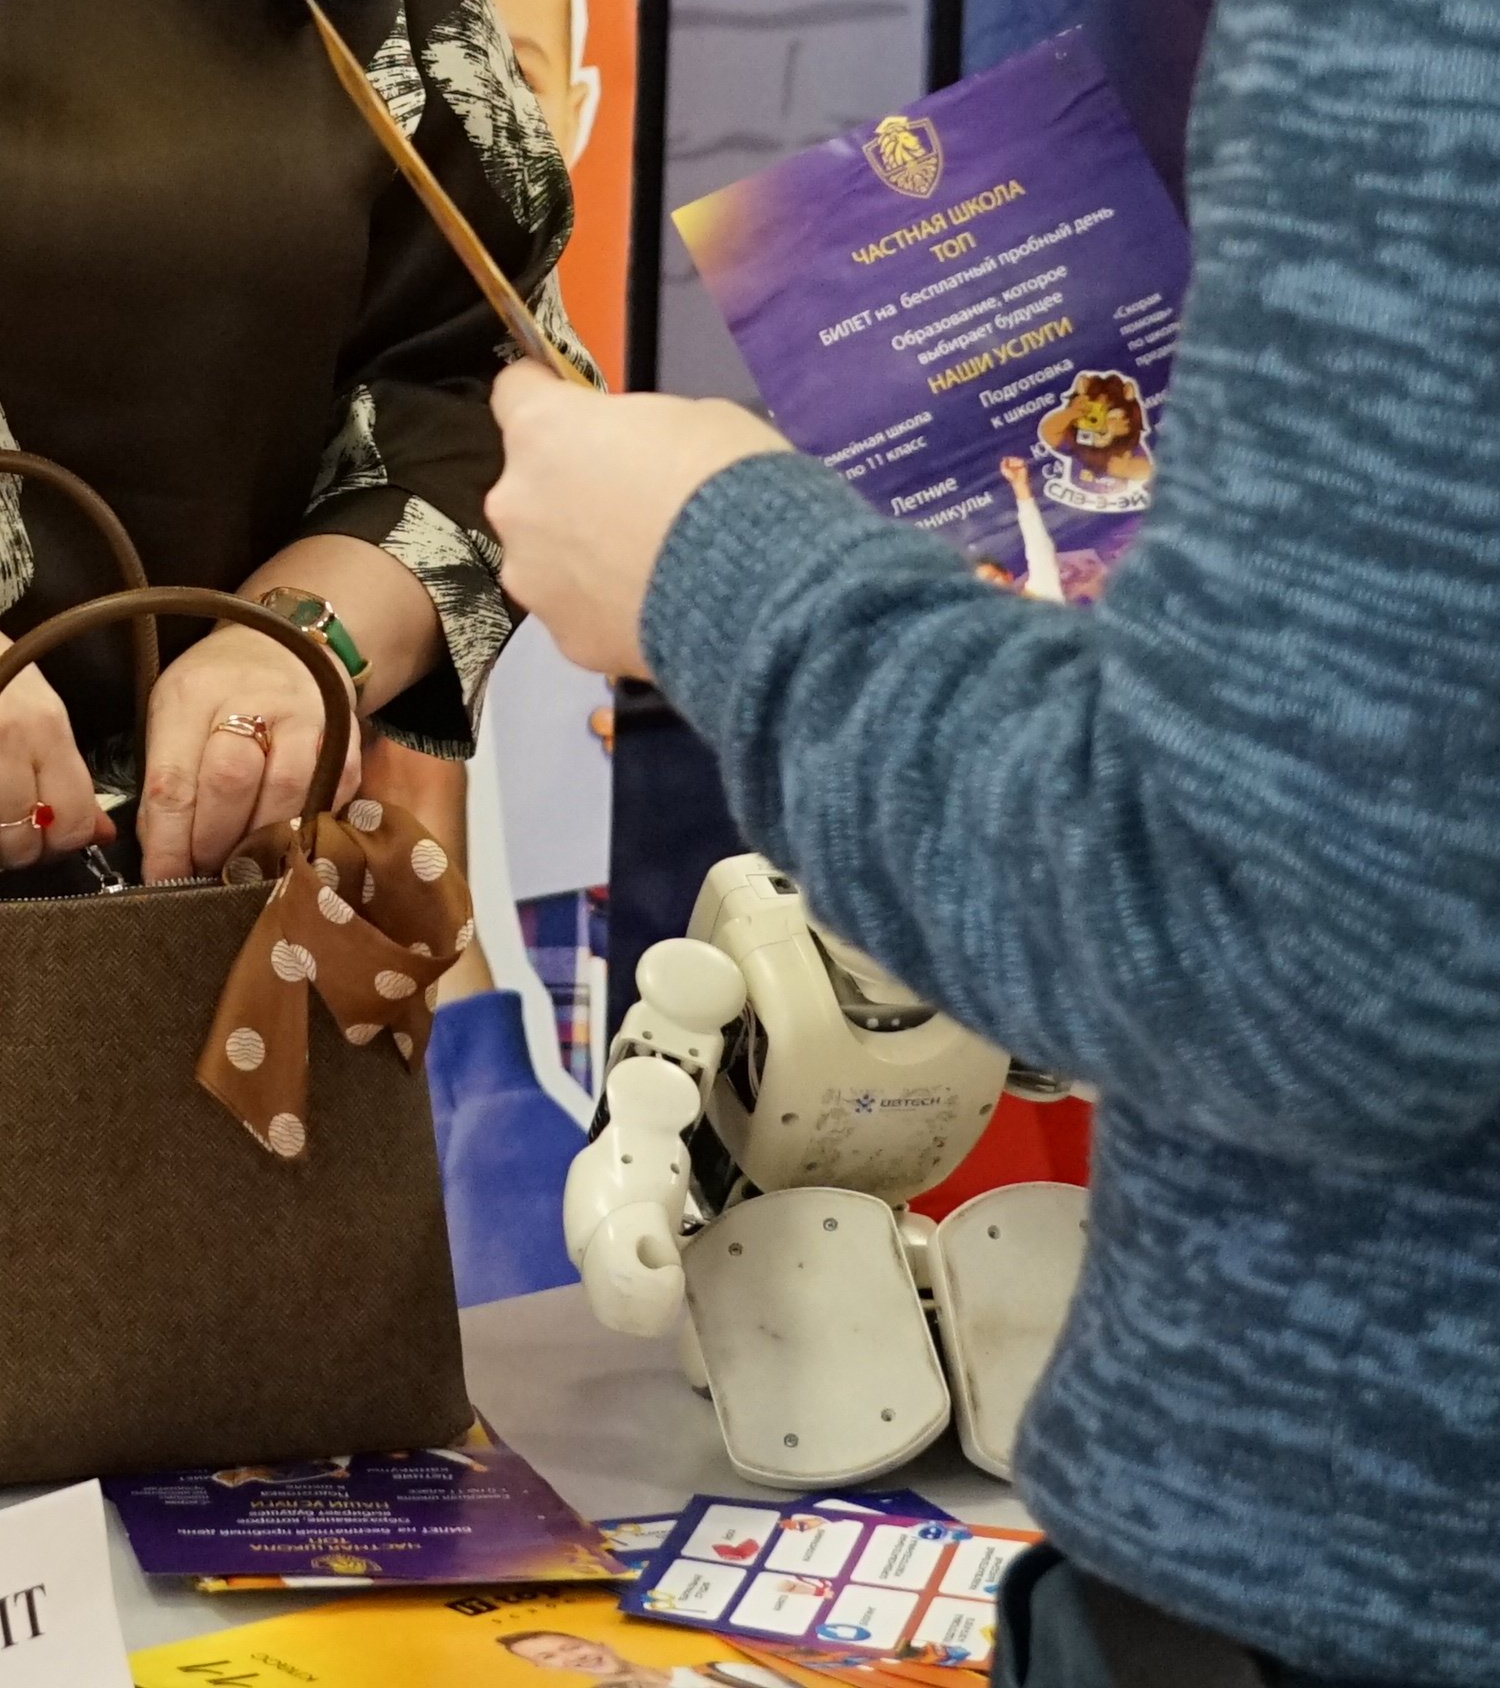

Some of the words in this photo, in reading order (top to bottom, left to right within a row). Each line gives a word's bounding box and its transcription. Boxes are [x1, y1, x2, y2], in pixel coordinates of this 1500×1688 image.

[852, 212, 947, 268] ЧАСТНАЯ
[947, 177, 1025, 226] ШКОЛА
[930, 231, 975, 263] ТОП
[819, 310, 873, 345] БИЛЕТ
[874, 303, 897, 321] на
[899, 254, 996, 309] бесплатный
[997, 221, 1073, 267] пробный
[1073, 204, 1115, 233] день
[891, 291, 1001, 353] Образование,
[1002, 264, 1067, 303] которое
[917, 321, 994, 367] выбирает
[995, 289, 1064, 332] будущее
[928, 353, 993, 394] НАШИ
[993, 316, 1073, 365] УСЛУГИ
[979, 353, 1074, 409] Подготовка
[991, 415, 1003, 428] к
[1004, 390, 1056, 423] школе
[821, 432, 885, 467] емейная
[885, 411, 934, 439] школа
[845, 464, 866, 480] по
[866, 453, 884, 469] 11
[886, 435, 928, 462] класс
[890, 476, 959, 517] Летние
[914, 490, 994, 528] аникулы
